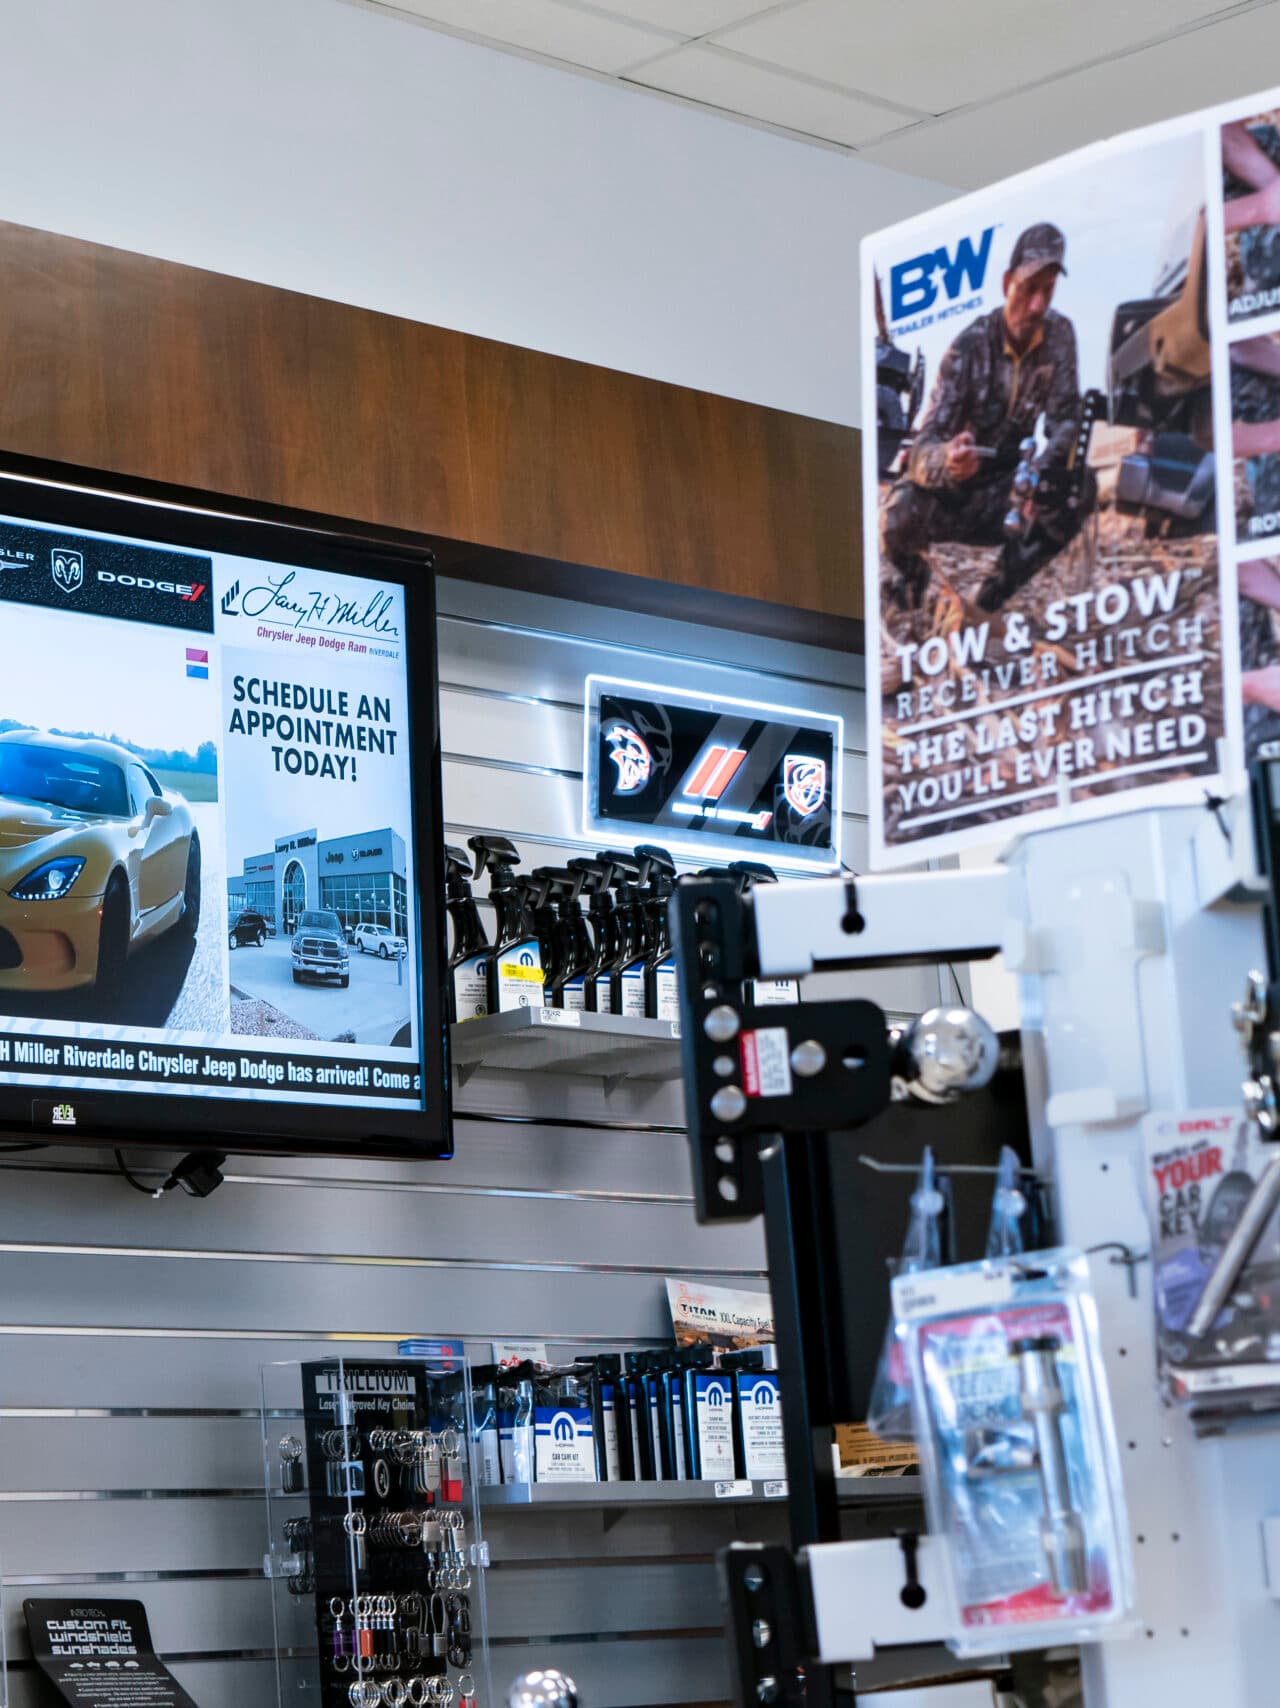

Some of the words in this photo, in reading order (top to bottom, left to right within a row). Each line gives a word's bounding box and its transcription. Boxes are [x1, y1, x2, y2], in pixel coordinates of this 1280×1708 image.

[1229, 286, 1280, 316] ADJU
[97, 570, 194, 596] DODGE
[241, 571, 310, 629] Larry
[327, 589, 400, 637] Miller
[256, 625, 293, 643] Chrysler
[295, 633, 317, 646] Jeep
[319, 636, 346, 652] Dodge
[347, 640, 367, 654] Ram
[369, 647, 399, 659] RIVERDALE
[895, 622, 990, 683] TOW
[1002, 612, 1032, 653] &
[895, 651, 1058, 720] RECEIVER
[1075, 616, 1205, 670] HITCH
[233, 675, 349, 717] SCHEDULE
[356, 695, 391, 723] AN
[229, 708, 397, 755] APPOINTMENT
[895, 730, 966, 774] THE
[975, 704, 1061, 755] LAST
[1070, 671, 1205, 730] HITCH
[271, 746, 357, 782] TODAY!
[898, 761, 1007, 813] YOU'LL
[1015, 737, 1097, 785] EVER
[1106, 714, 1208, 761] NEED
[0, 1041, 10, 1061] H
[14, 1041, 59, 1065] Miller
[64, 1045, 134, 1071] Riverdale
[138, 1051, 199, 1078] Chrysler
[202, 1055, 237, 1081] Jeep
[240, 1058, 285, 1085] Dodge
[287, 1061, 313, 1083] has
[316, 1064, 369, 1087] arrived!
[373, 1068, 410, 1090] Come
[1152, 1146, 1223, 1195] YOUR
[681, 1303, 716, 1316] TITAN
[323, 1369, 409, 1391] TRILLIUM
[377, 1398, 391, 1412] Key
[392, 1398, 415, 1410] Chains
[46, 1620, 108, 1630] custom
[48, 1631, 132, 1642] windshield
[51, 1643, 137, 1655] sunshades
